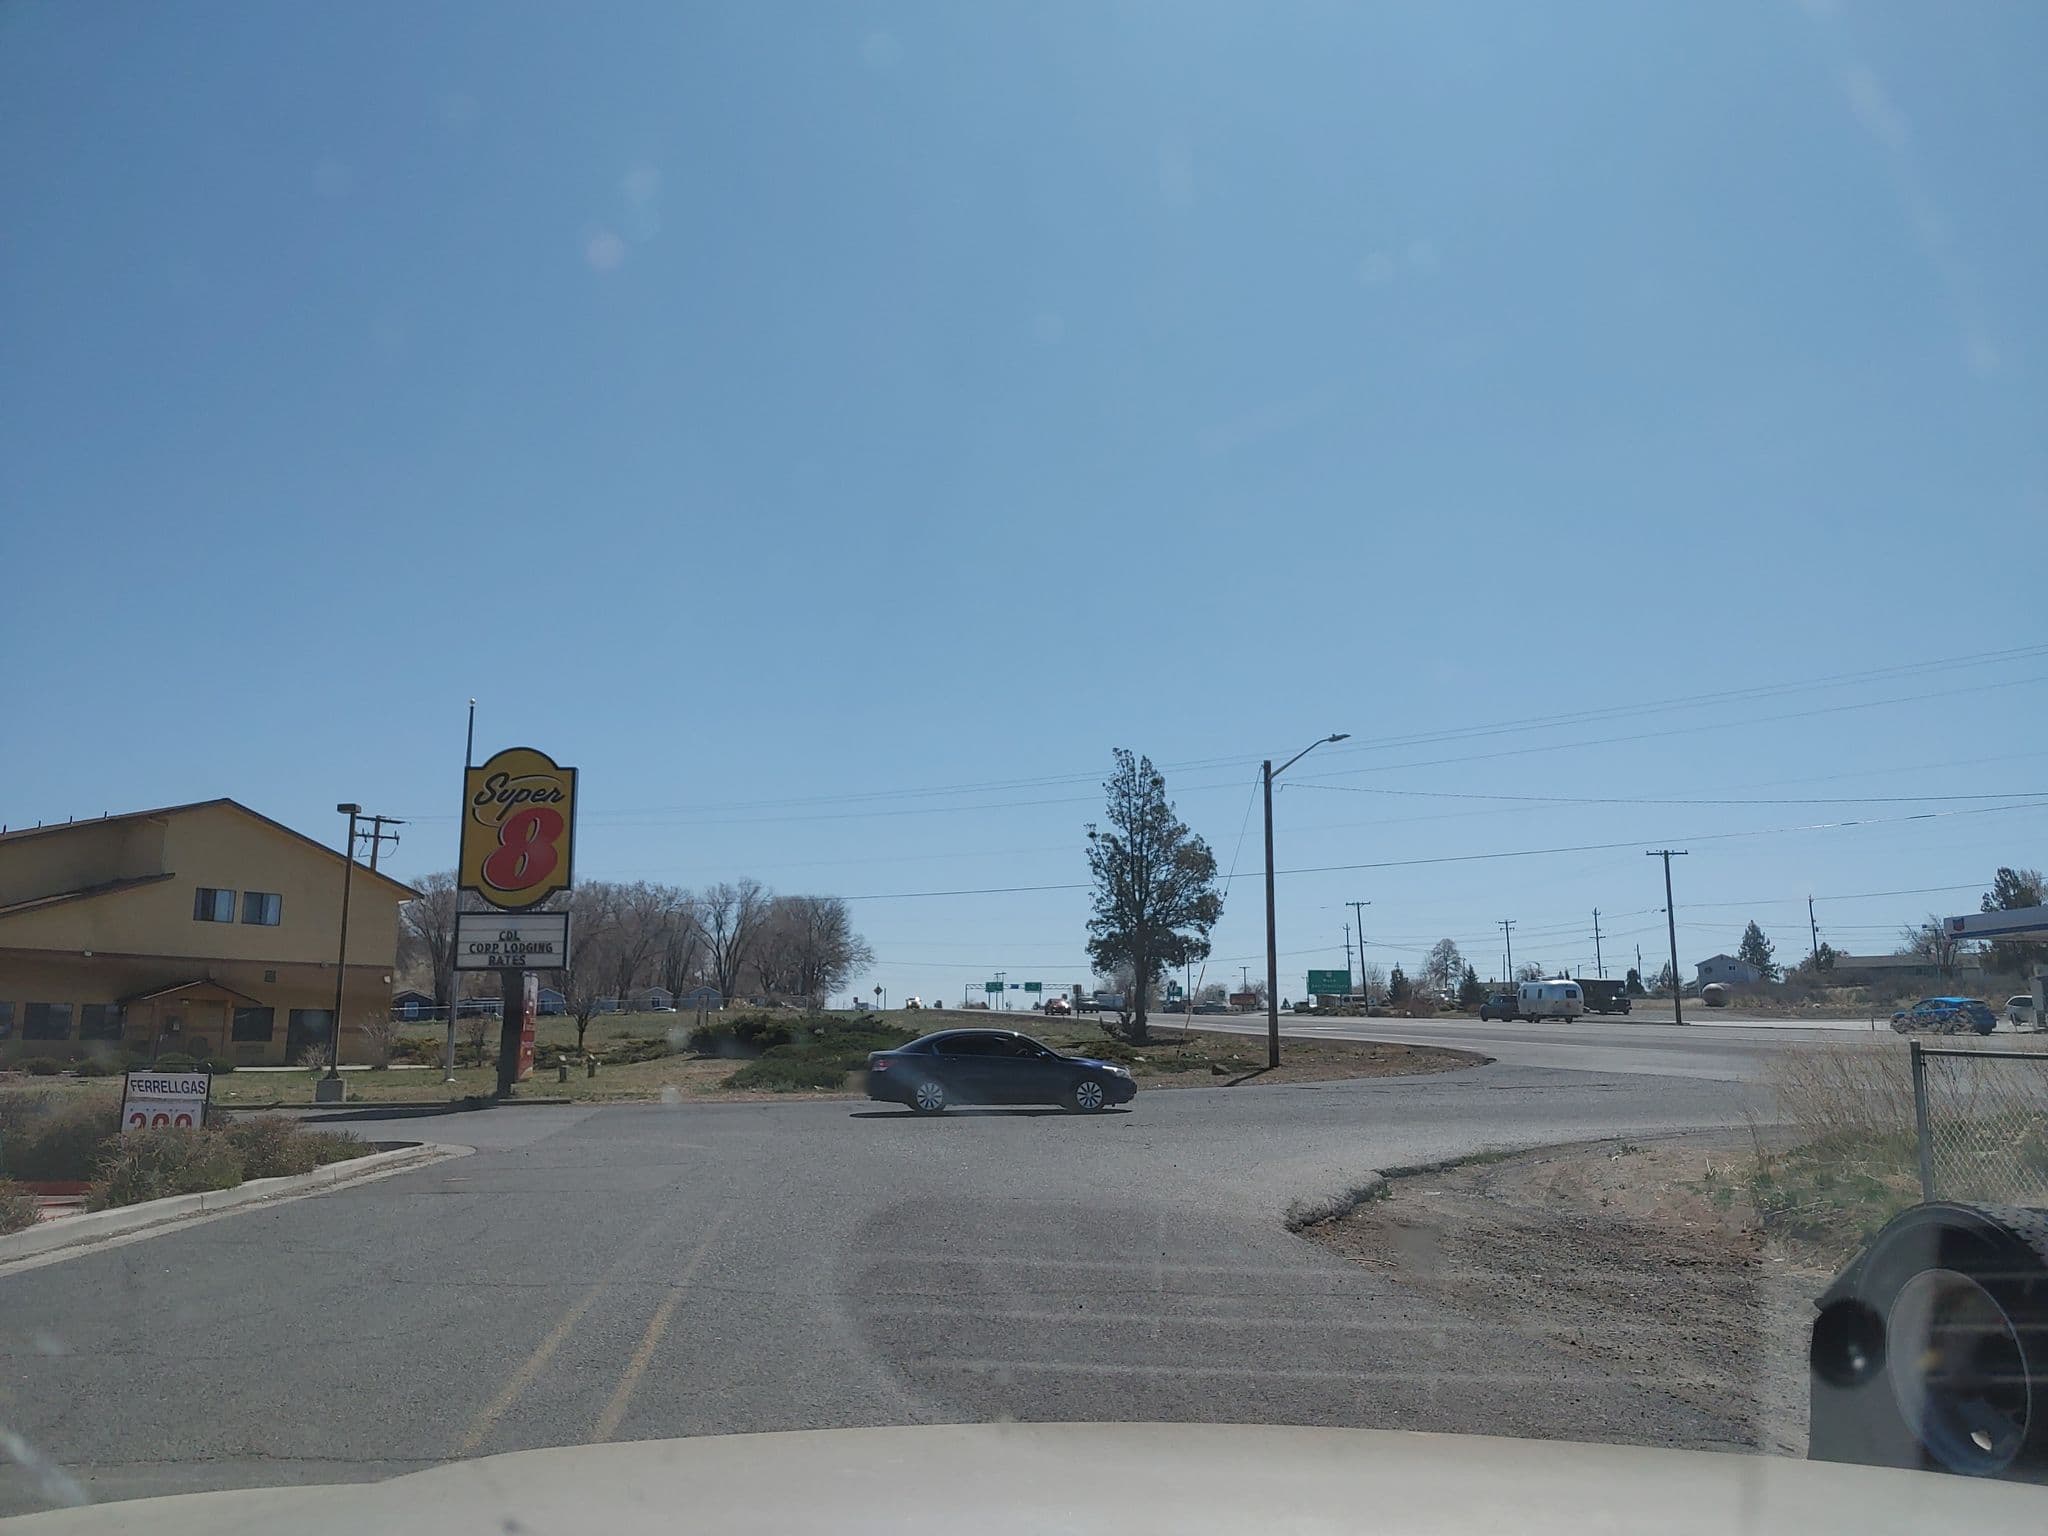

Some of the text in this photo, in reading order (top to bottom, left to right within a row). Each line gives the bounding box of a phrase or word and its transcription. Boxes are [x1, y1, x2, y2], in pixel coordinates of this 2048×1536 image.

[473, 772, 565, 821] Super
[481, 807, 564, 891] 8
[499, 930, 520, 942] CDL
[469, 942, 553, 954] CORP LODGING
[488, 955, 526, 966] RATES
[130, 1080, 206, 1095] FERRELLGAS
